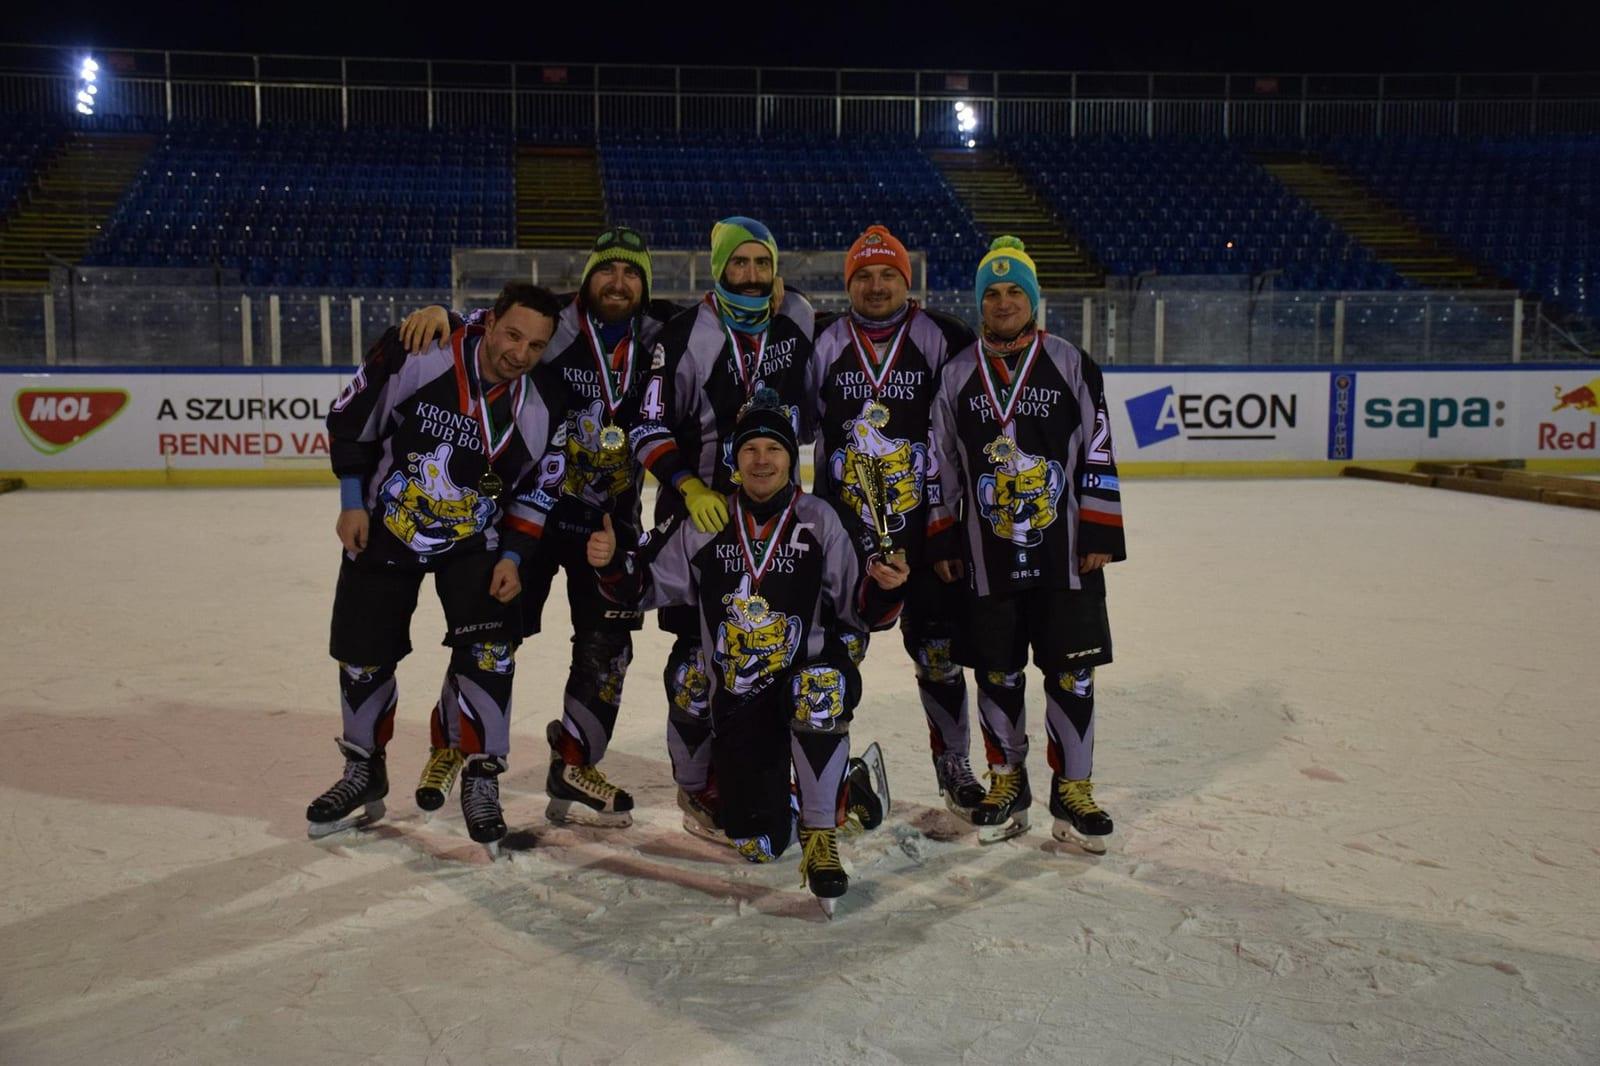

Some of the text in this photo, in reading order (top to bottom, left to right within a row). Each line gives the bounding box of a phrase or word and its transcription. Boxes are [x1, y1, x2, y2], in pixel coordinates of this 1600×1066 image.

[763, 353, 793, 376] BOYS
[835, 371, 925, 386] KROTADT
[640, 375, 664, 421] 4
[843, 384, 915, 400] PUB BOYS
[30, 397, 92, 421] MOL
[157, 399, 178, 420] A
[416, 401, 481, 436] KRONST
[1015, 401, 1050, 418] BOYS
[1156, 394, 1297, 431] AEGON
[420, 418, 455, 441] PUB
[1087, 409, 1111, 466] 2
[1539, 421, 1596, 449] Red
[159, 432, 333, 455] BENNED VA
[765, 558, 796, 574] OYS
